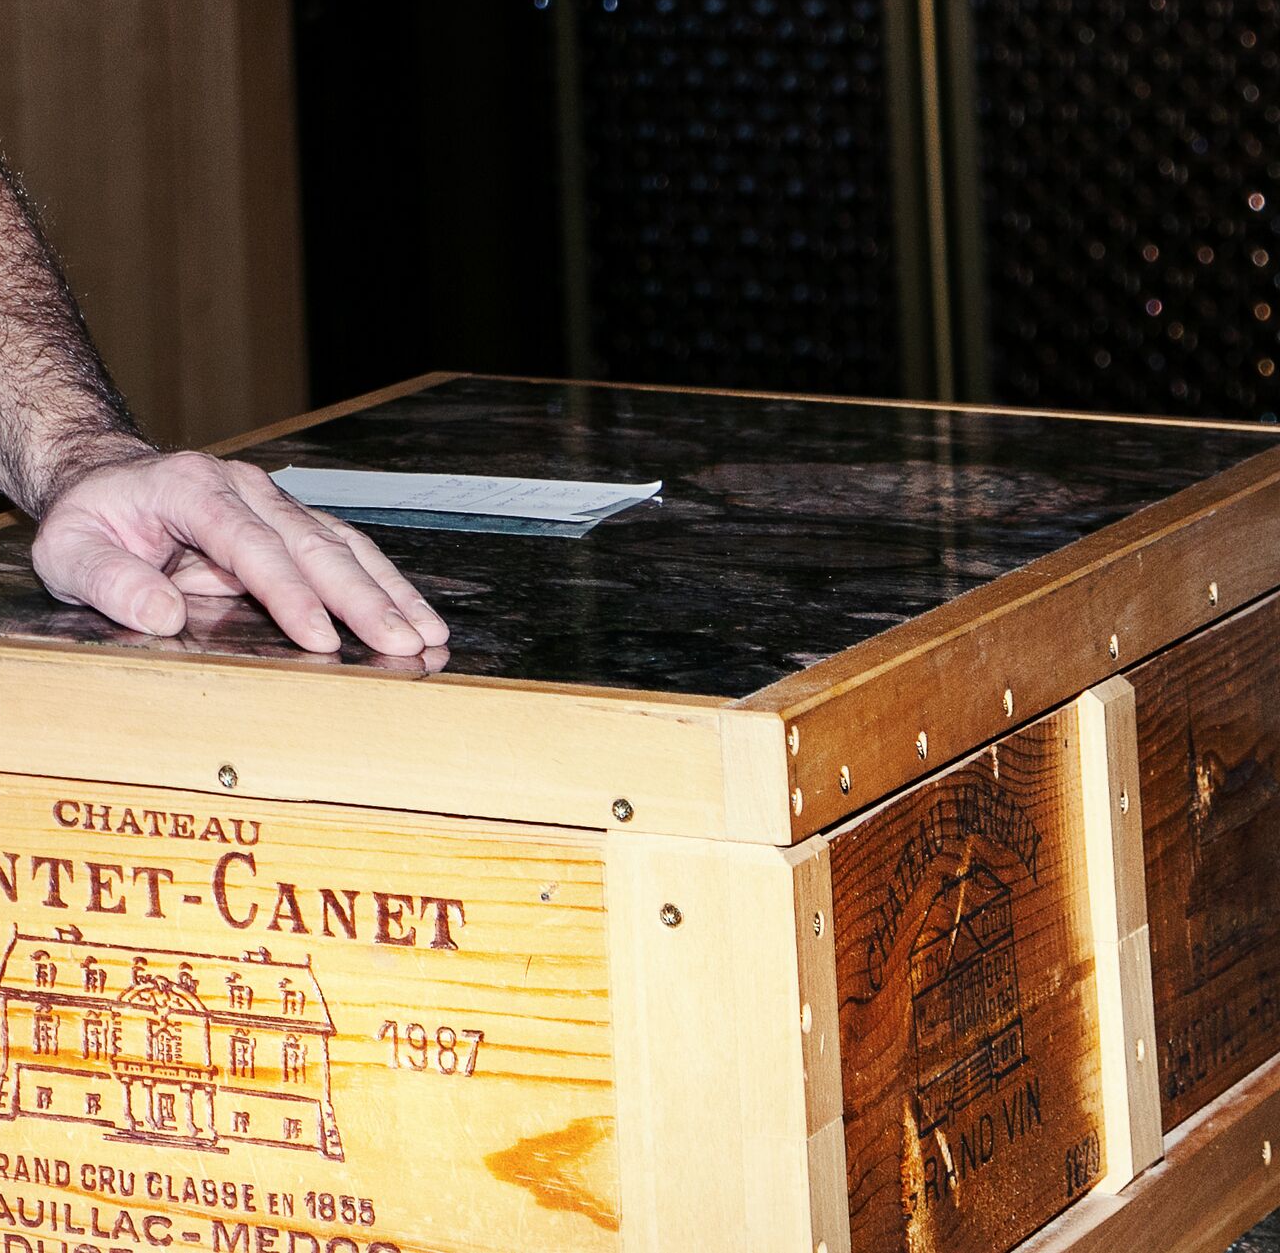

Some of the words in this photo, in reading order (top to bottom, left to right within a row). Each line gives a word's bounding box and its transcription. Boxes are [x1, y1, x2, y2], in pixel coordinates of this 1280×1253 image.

[52, 799, 263, 847] CHATEAU
[867, 798, 943, 992] CHATEAU
[376, 1019, 485, 1077] 1987
[1002, 1075, 1041, 1145] VIN
[80, 1162, 135, 1197] CRU
[146, 1170, 257, 1213] CLASSE
[268, 1191, 294, 1217] EN
[304, 1190, 376, 1227] 1855
